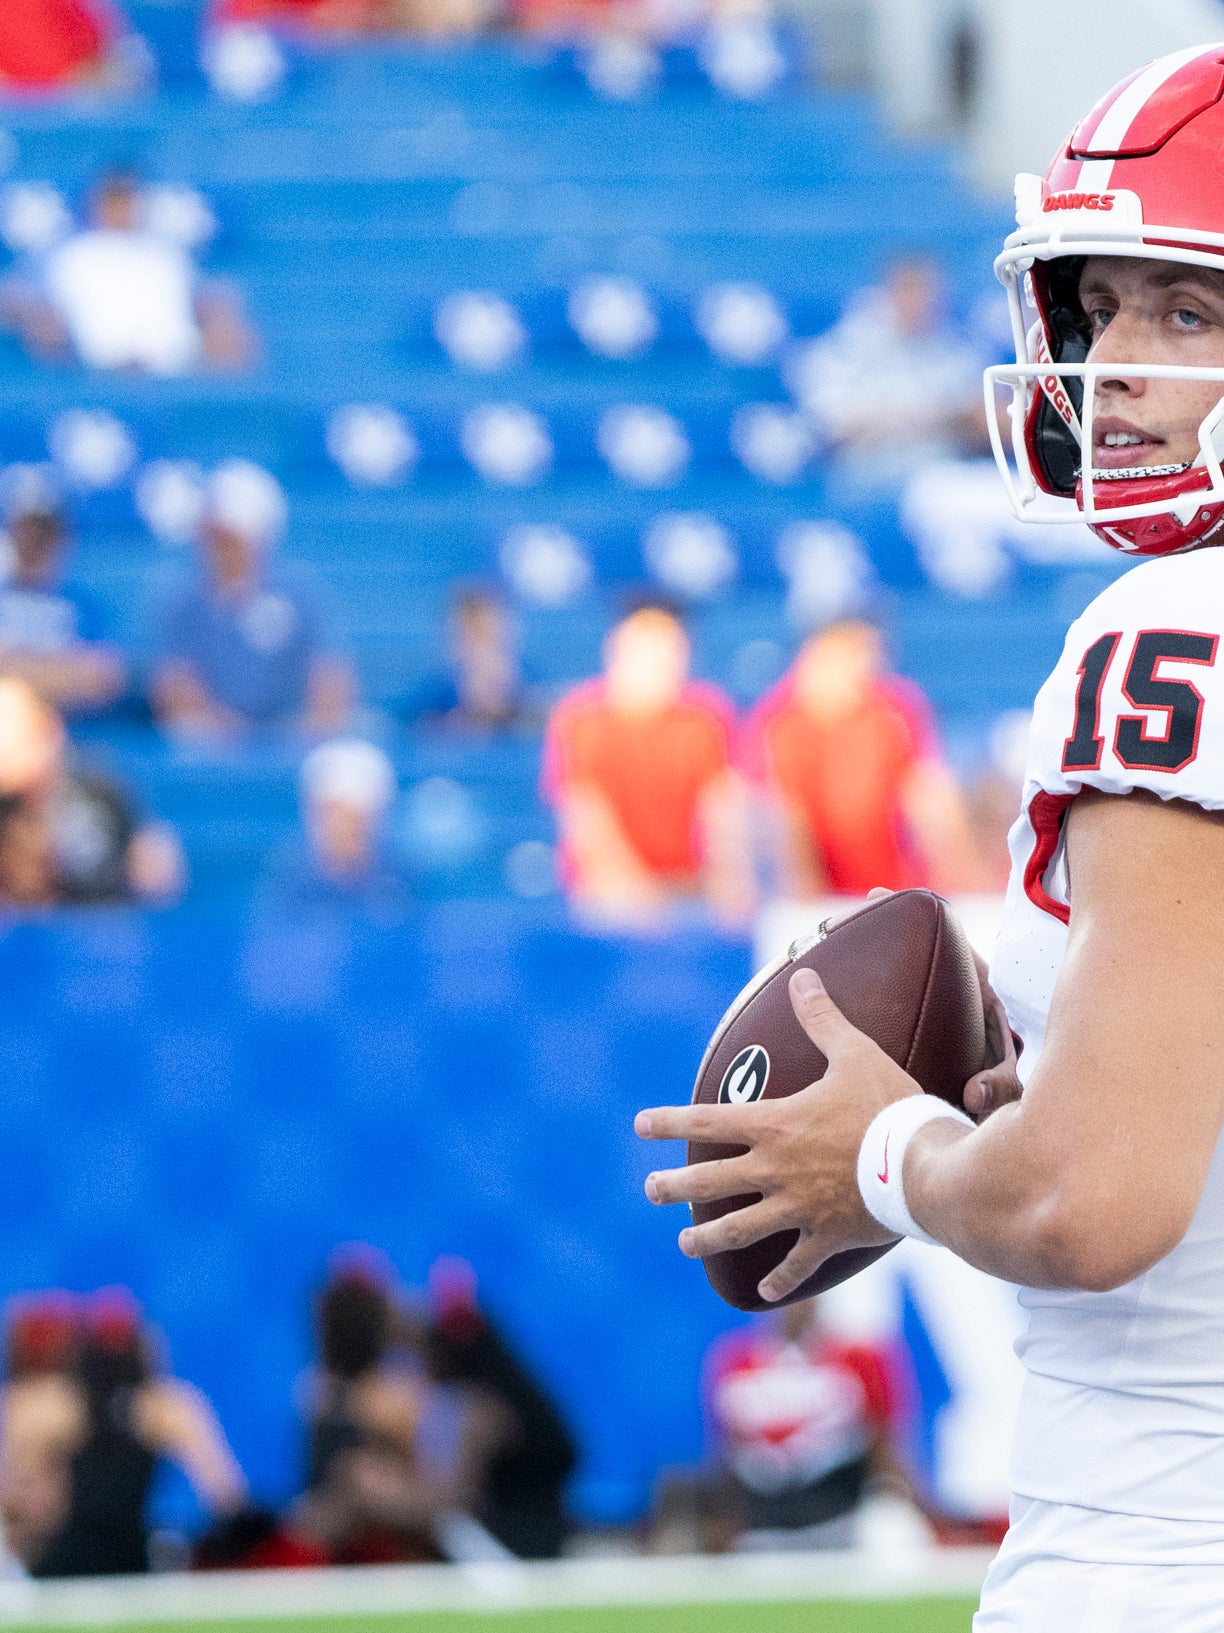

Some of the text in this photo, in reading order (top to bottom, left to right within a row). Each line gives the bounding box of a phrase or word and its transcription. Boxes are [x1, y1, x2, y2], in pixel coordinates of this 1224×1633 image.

[1043, 193, 1116, 212] DAWGS
[1061, 628, 1220, 774] 15
[718, 1045, 770, 1104] G
